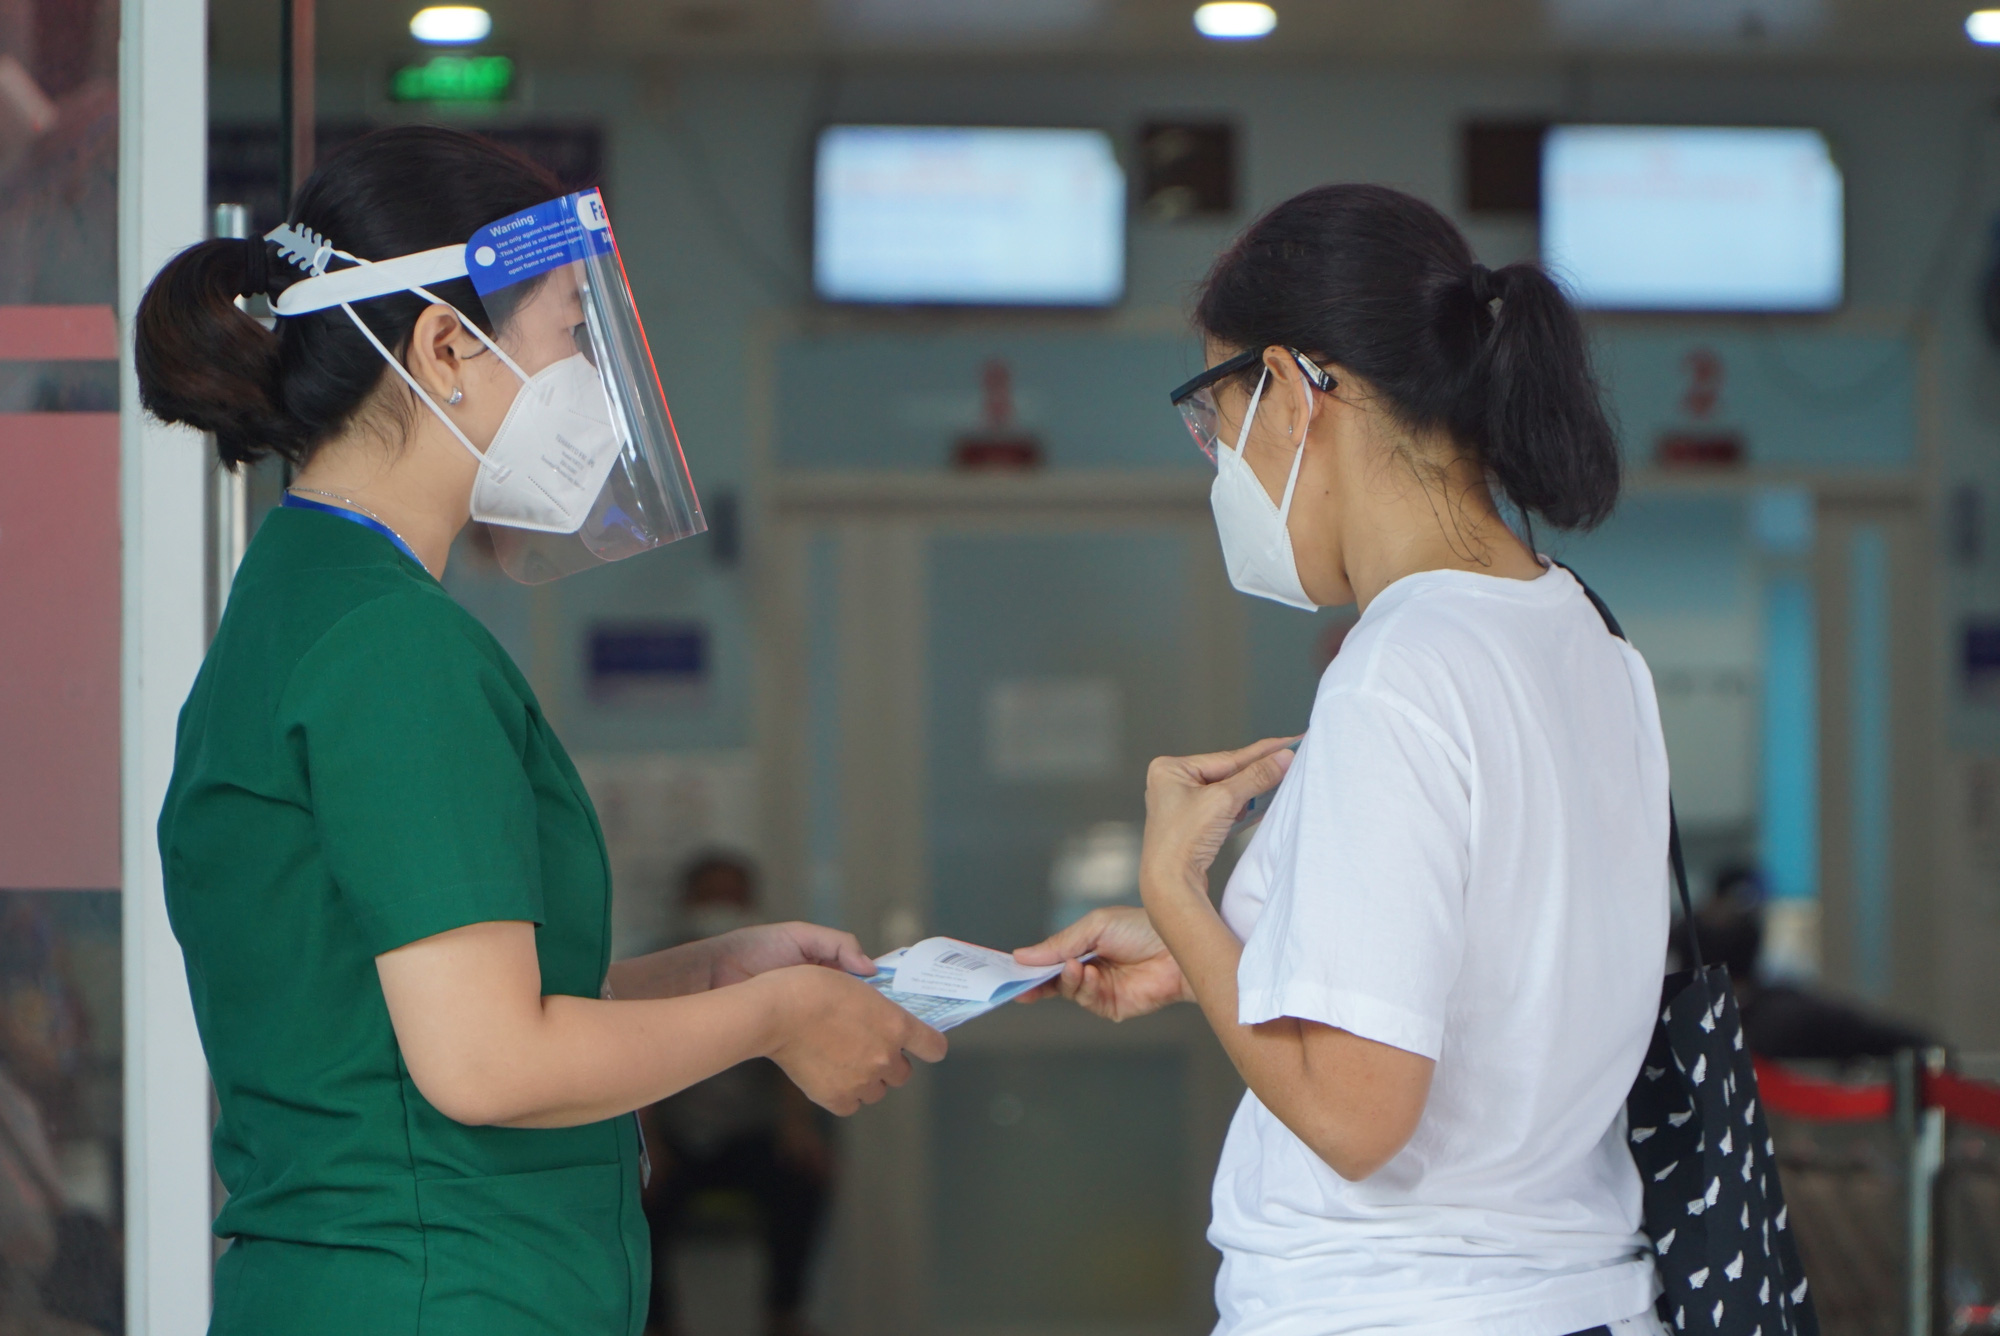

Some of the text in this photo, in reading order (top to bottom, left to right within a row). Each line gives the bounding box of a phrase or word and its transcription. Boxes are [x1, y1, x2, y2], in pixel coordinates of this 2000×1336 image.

[490, 214, 538, 237] Warning:
[496, 241, 508, 249] Use
[509, 236, 521, 244] only
[522, 228, 542, 239] against
[514, 241, 531, 252] shield
[547, 231, 564, 241] impact
[514, 254, 524, 262] not
[524, 251, 535, 259] use
[543, 240, 567, 252] protection
[508, 266, 523, 275] open
[523, 260, 539, 269] flame
